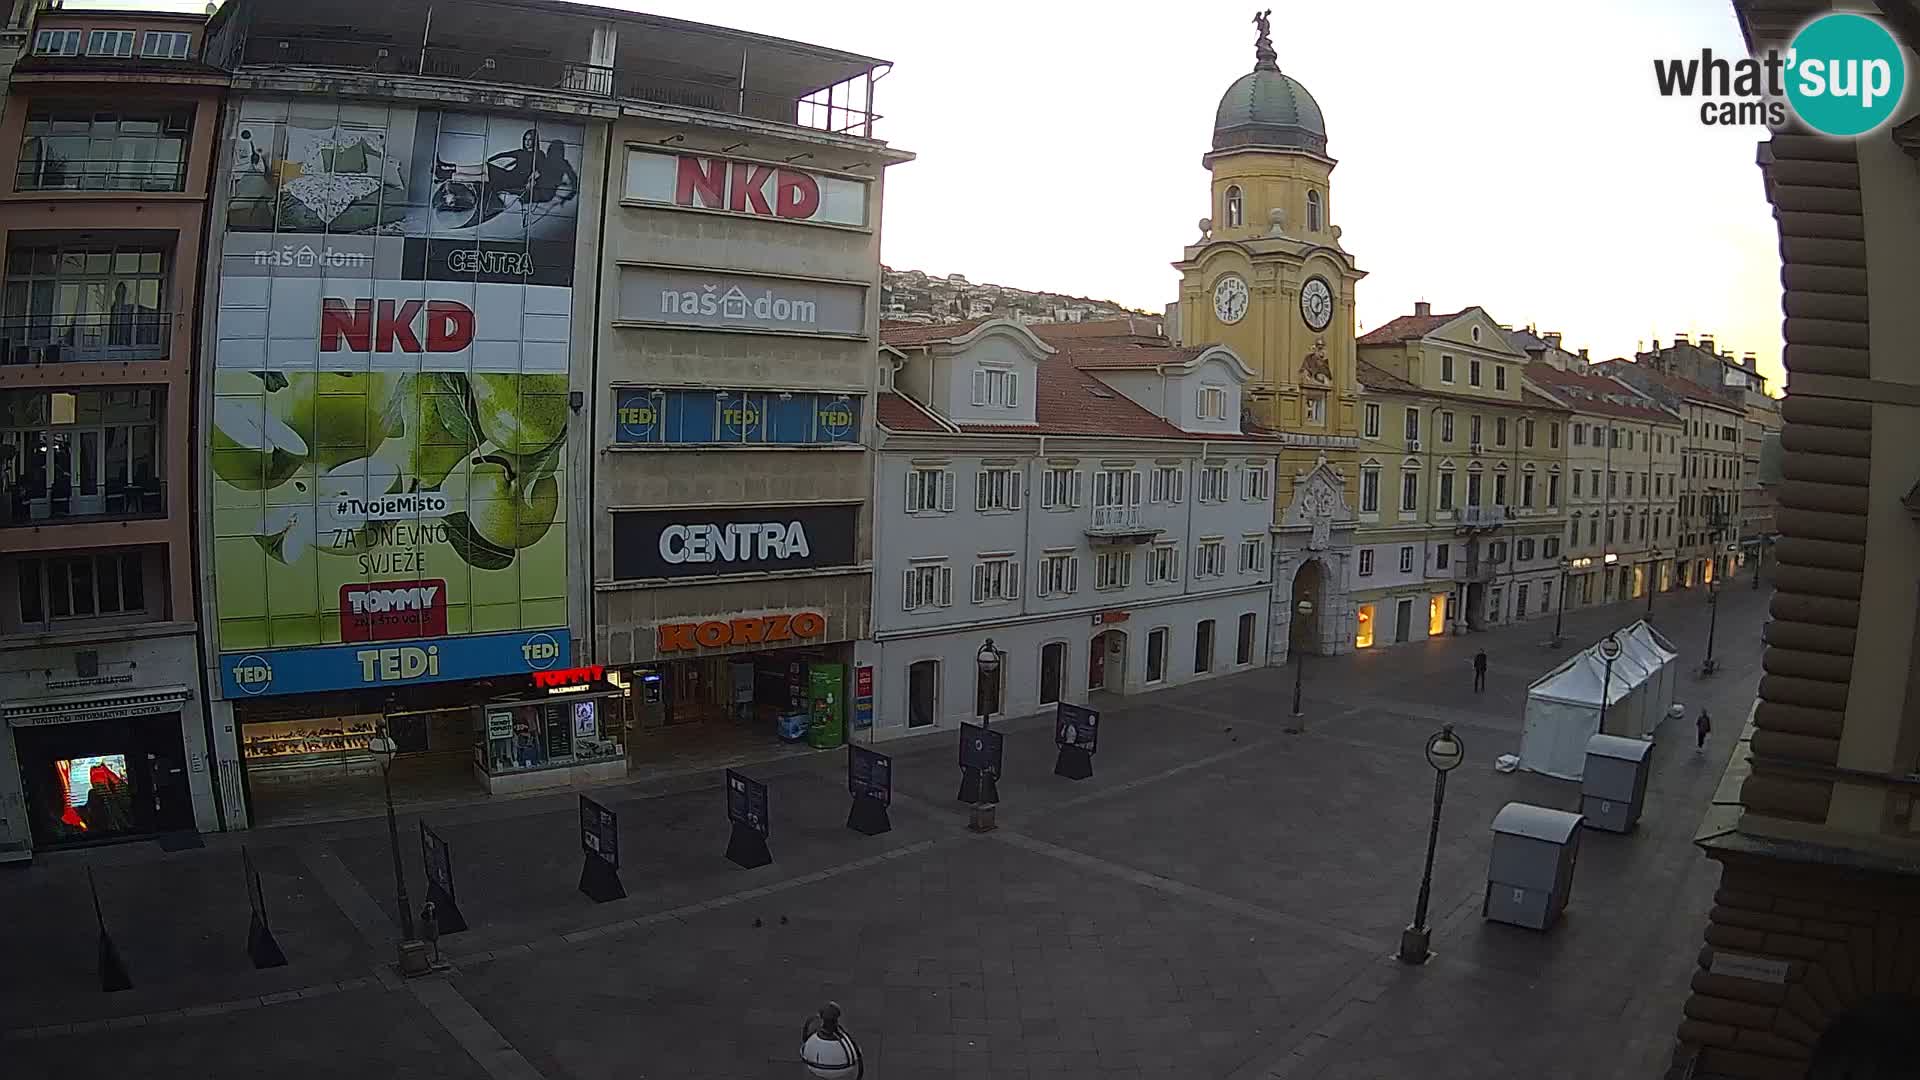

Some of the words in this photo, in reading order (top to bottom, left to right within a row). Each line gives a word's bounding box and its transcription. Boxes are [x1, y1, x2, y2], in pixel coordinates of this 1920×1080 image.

[676, 156, 820, 220] NKD
[254, 244, 295, 267] naš
[318, 247, 366, 268] dom
[447, 249, 535, 275] CENTRA
[661, 283, 717, 315] naš
[753, 290, 816, 323] dom
[320, 297, 477, 353] NKD
[618, 408, 657, 425] TEDi
[723, 409, 760, 425] TEDi
[819, 411, 853, 426] TEDi
[337, 497, 446, 516] #TvojeMisto
[332, 528, 357, 549] ZA
[366, 523, 449, 548] DNEVNO
[658, 520, 810, 565] CENTRA
[359, 547, 426, 575] SVJEŽE
[347, 587, 438, 613] TOMMY
[658, 612, 825, 653] KORZO
[356, 646, 439, 682] TEDi
[522, 641, 560, 663] TEDi
[233, 665, 273, 686] TEDi
